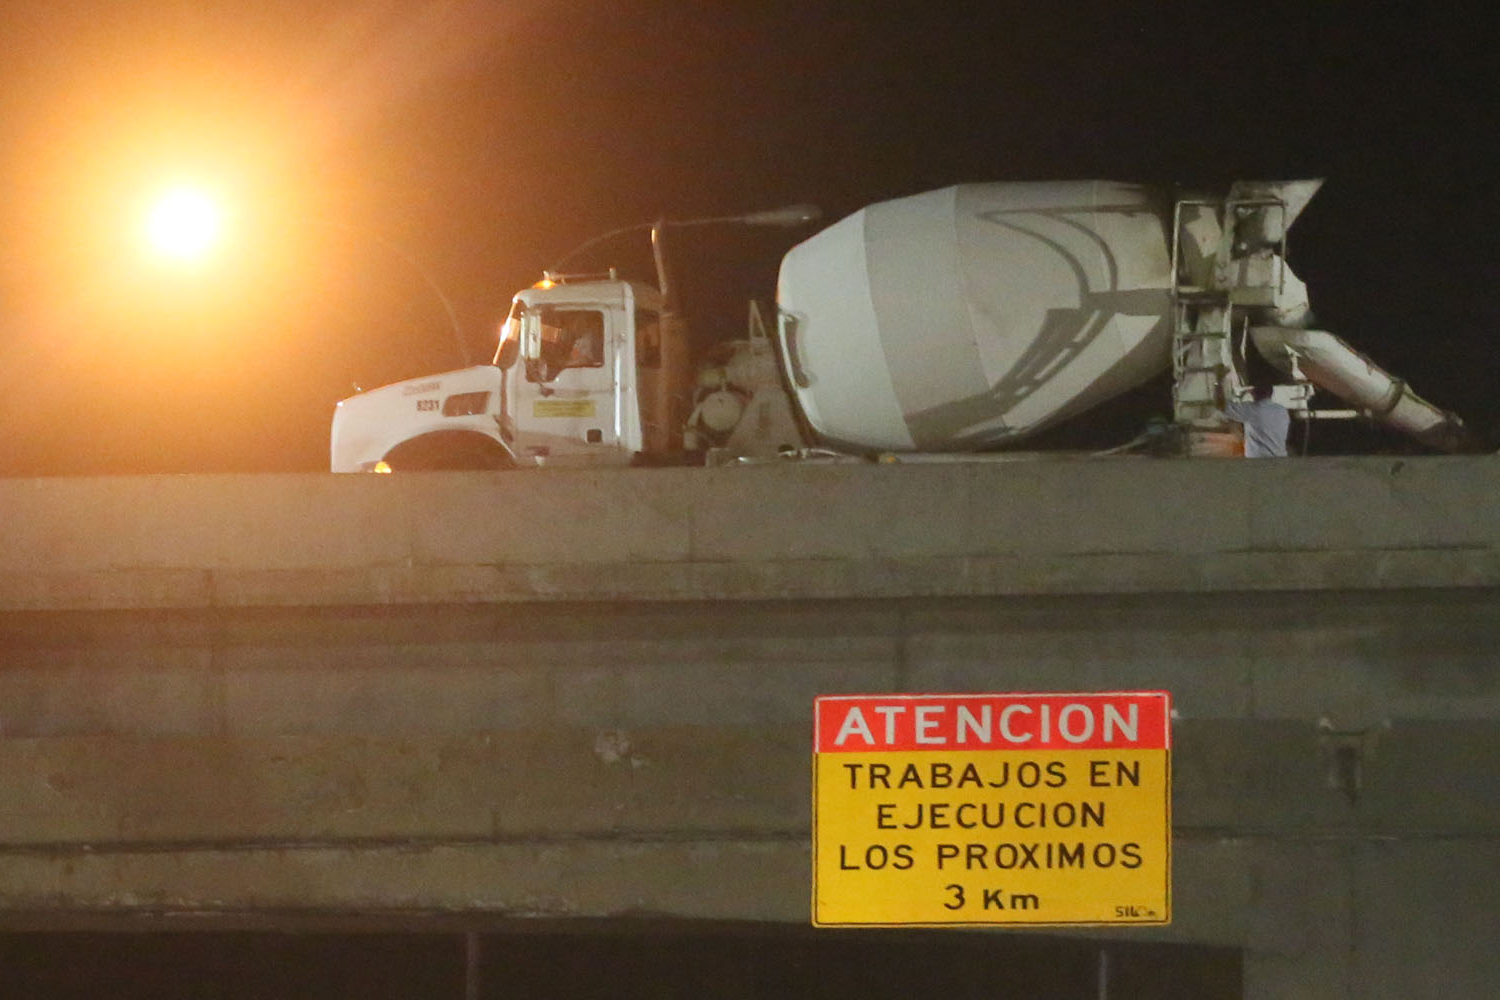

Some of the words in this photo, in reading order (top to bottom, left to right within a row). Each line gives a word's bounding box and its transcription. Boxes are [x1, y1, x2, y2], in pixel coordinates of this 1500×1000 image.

[834, 703, 1138, 745] ATENCION
[844, 762, 1066, 789] TRABAJOS
[1090, 761, 1140, 787] EN
[877, 802, 1105, 829] EJECUCION
[840, 844, 914, 870] LOS
[937, 842, 1143, 870] PROXIMOS
[944, 884, 965, 909] 3
[983, 889, 1040, 910] Km
